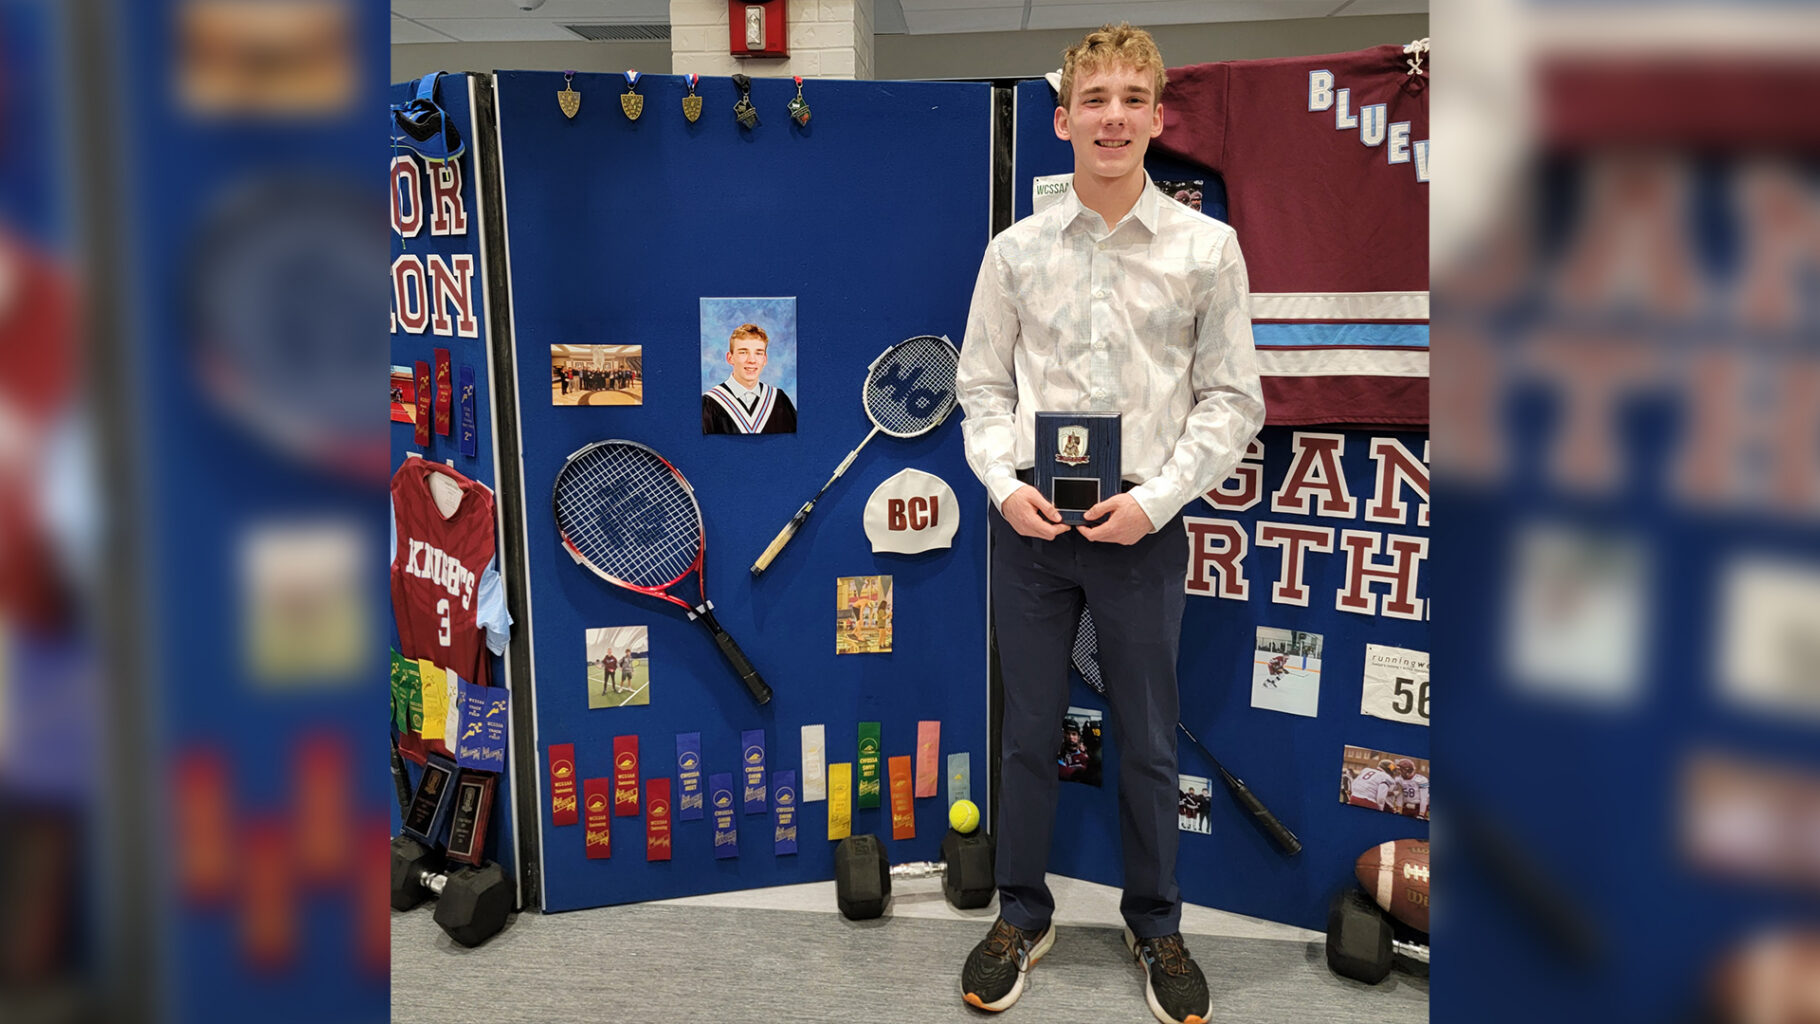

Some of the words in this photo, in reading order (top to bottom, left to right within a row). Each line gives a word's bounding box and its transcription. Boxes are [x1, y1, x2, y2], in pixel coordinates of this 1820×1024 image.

[391, 155, 467, 237] OR
[391, 254, 478, 338] ON
[888, 496, 939, 531] BCI
[405, 538, 475, 611] KNIGHTS
[1183, 516, 1429, 621] RTH
[436, 598, 450, 647] 3
